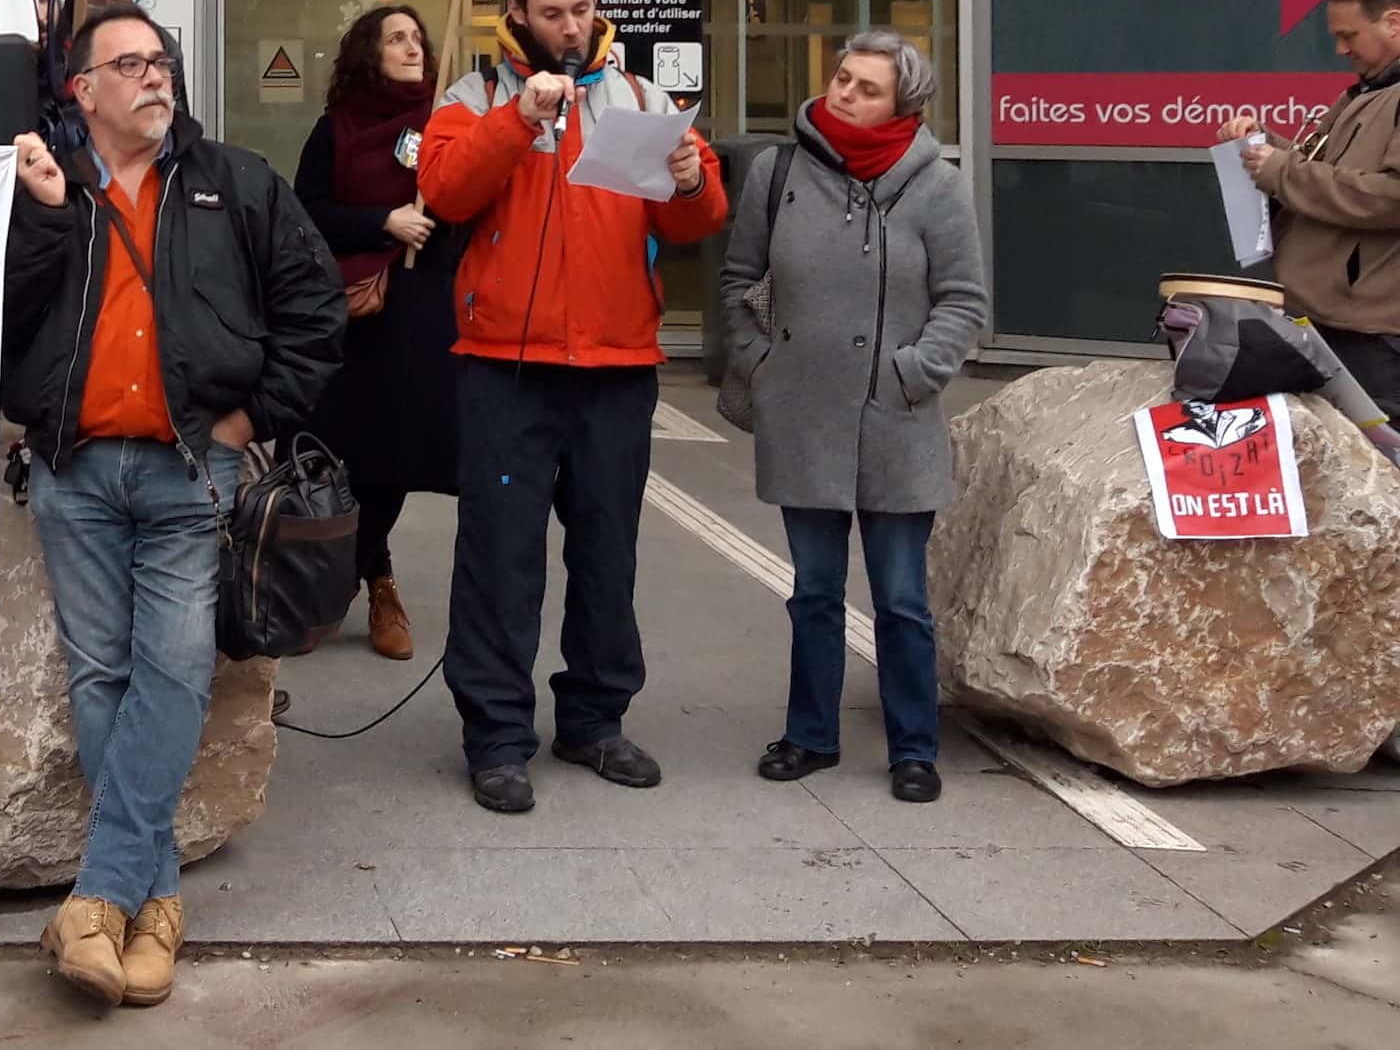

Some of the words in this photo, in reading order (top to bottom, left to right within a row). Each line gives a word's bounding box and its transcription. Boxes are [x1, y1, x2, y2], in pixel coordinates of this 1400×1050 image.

[631, 8, 645, 19] et
[647, 7, 702, 19] d'utiliser
[619, 21, 672, 33] cendrier
[998, 94, 1086, 124] faites
[1095, 101, 1152, 125] vos
[1161, 94, 1331, 126] démarche
[1171, 493, 1204, 517] ON
[1209, 491, 1249, 518] EST
[1254, 487, 1287, 515] LÀ
